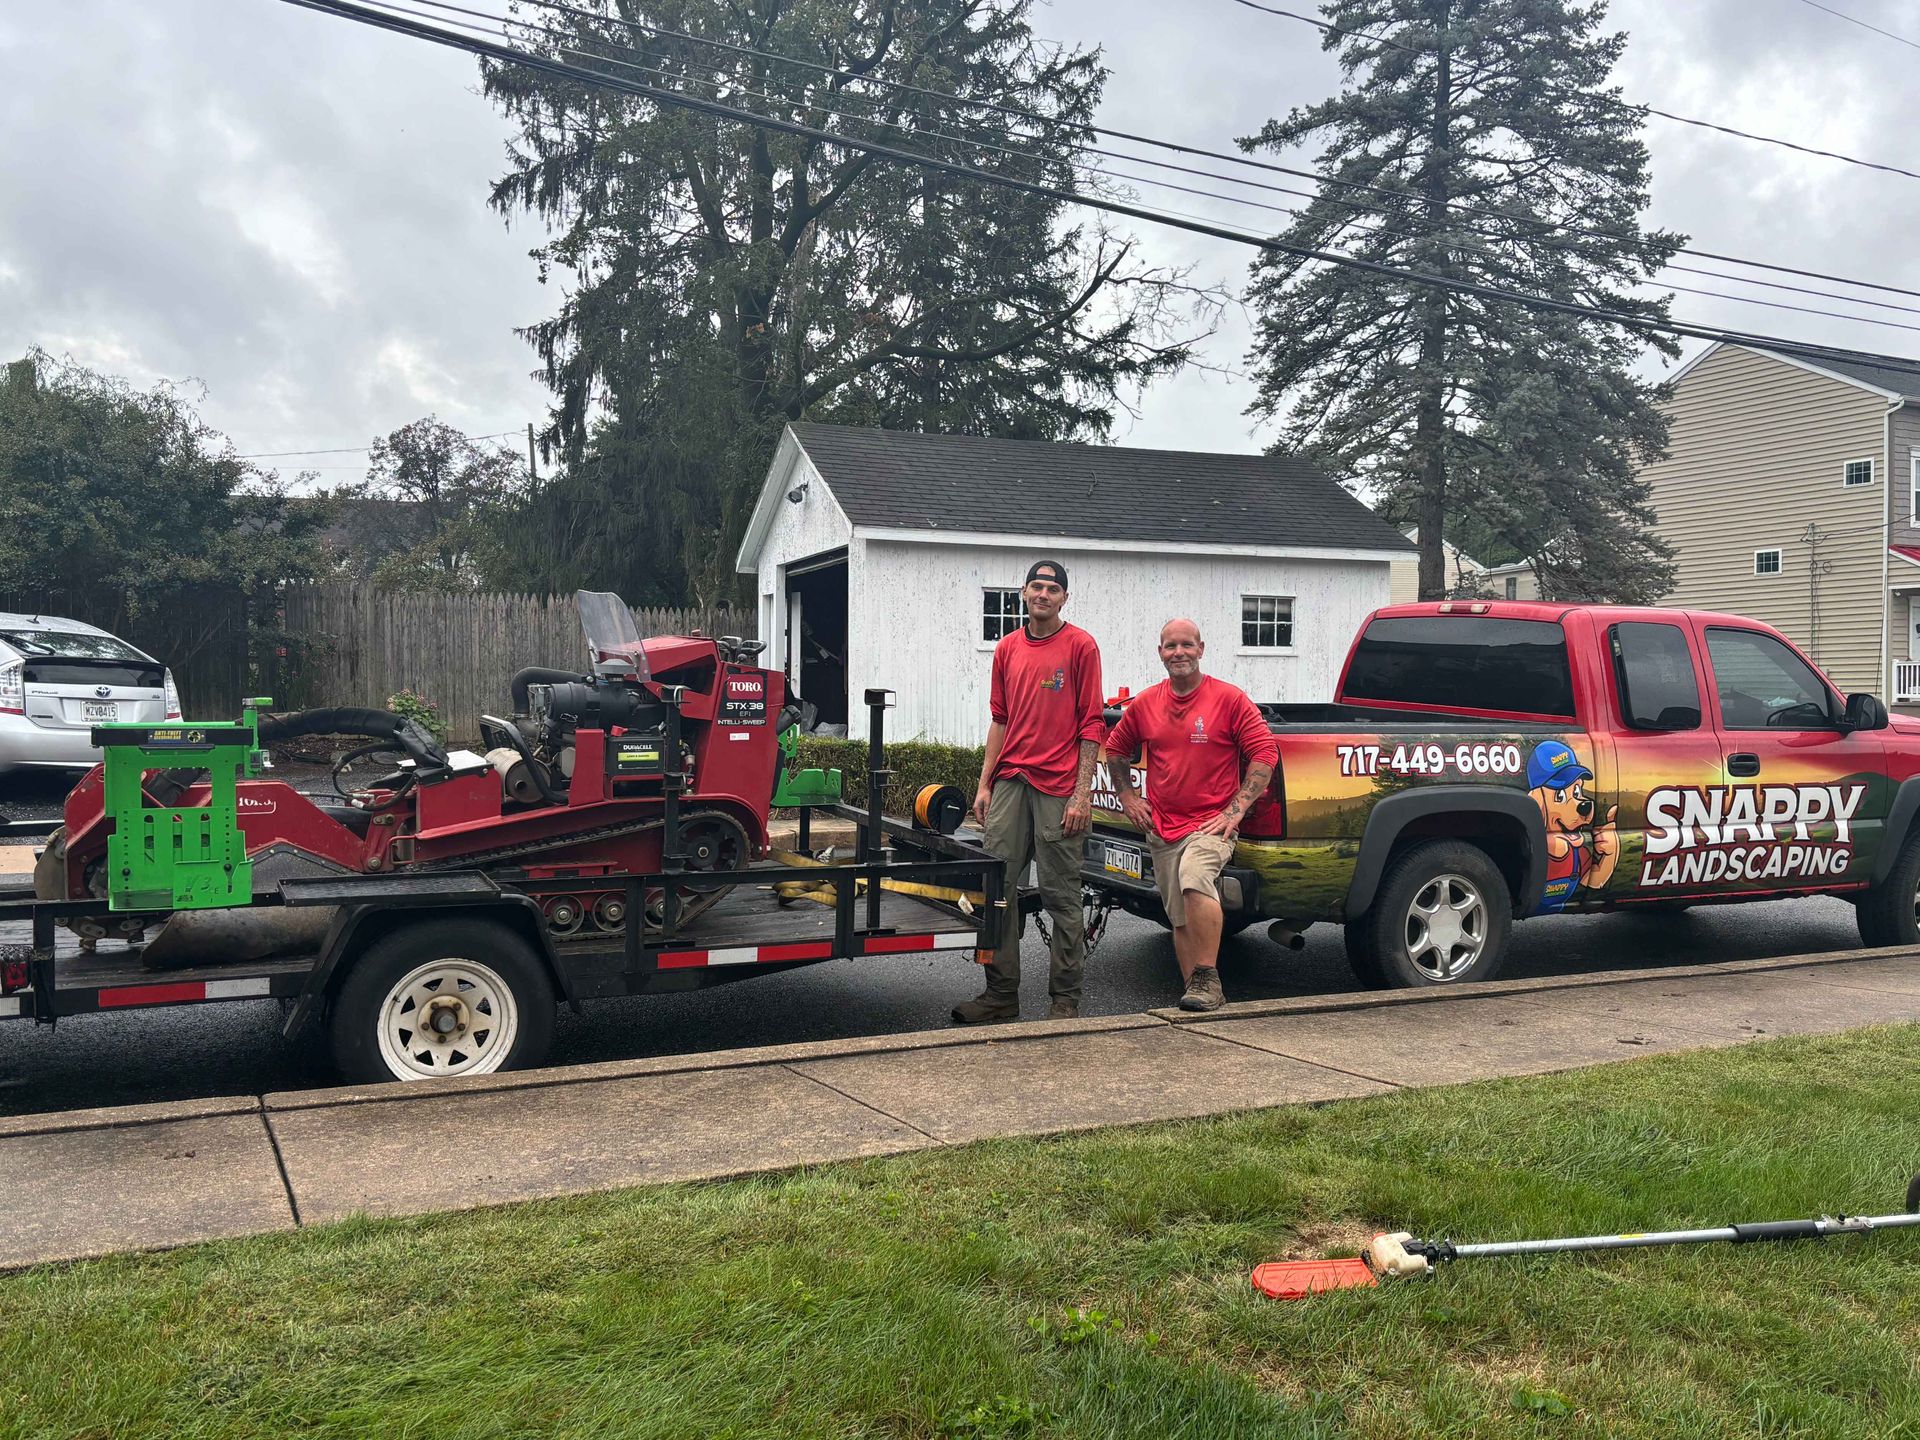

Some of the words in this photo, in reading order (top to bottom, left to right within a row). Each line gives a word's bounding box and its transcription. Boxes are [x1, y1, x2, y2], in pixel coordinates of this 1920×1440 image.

[730, 681, 762, 692] TORO
[1337, 745, 1521, 775] 717-449-6660
[1645, 785, 1867, 855] SNAPPY
[1640, 846, 1851, 887] LANDSCAPING
